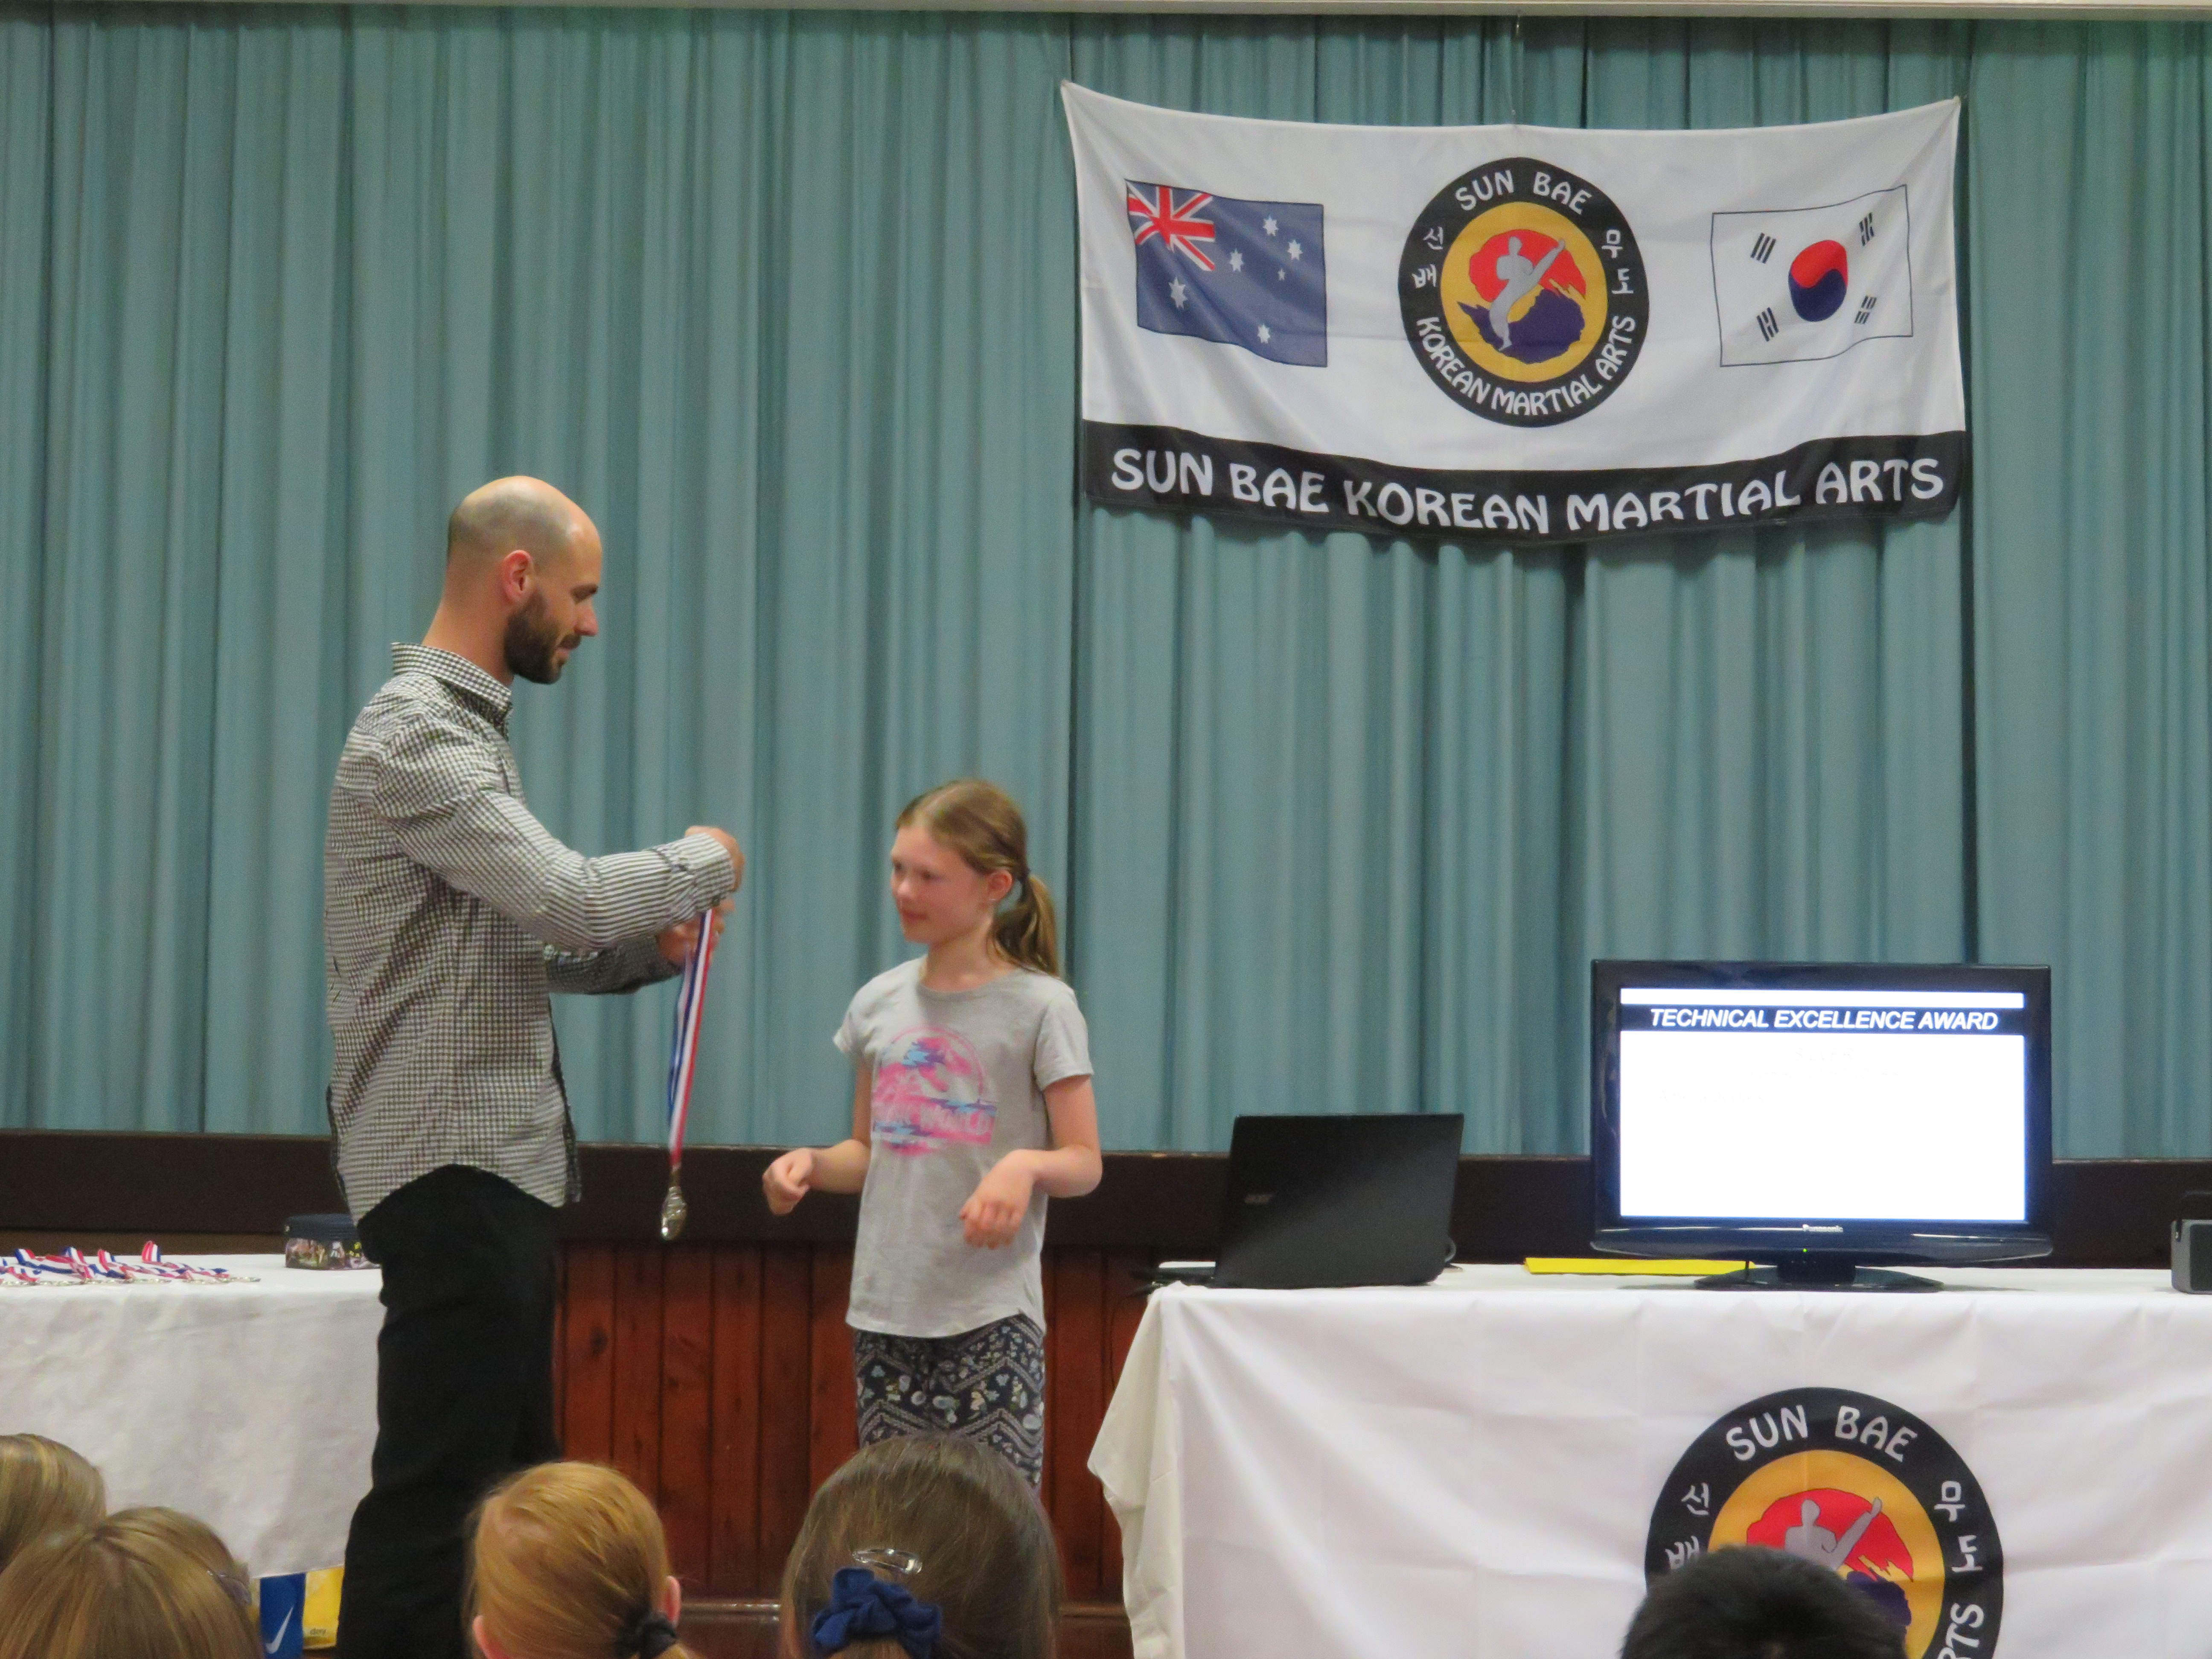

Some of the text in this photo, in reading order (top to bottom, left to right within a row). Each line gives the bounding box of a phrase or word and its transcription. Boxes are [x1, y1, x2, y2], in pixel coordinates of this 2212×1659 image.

[1455, 169, 1592, 215] SUN BAE
[1601, 229, 1634, 295] 무도
[1416, 315, 1636, 416] KOREAN MARTIAL ARTS
[1111, 448, 1944, 534] SUN BAE KOREAN MARTIAL ARTS
[1650, 1008, 1999, 1030] TECHNICAL EXCELLENCE AWARD
[1726, 1404, 1918, 1462] SUN BAE
[1934, 1480, 1983, 1573] 무도
